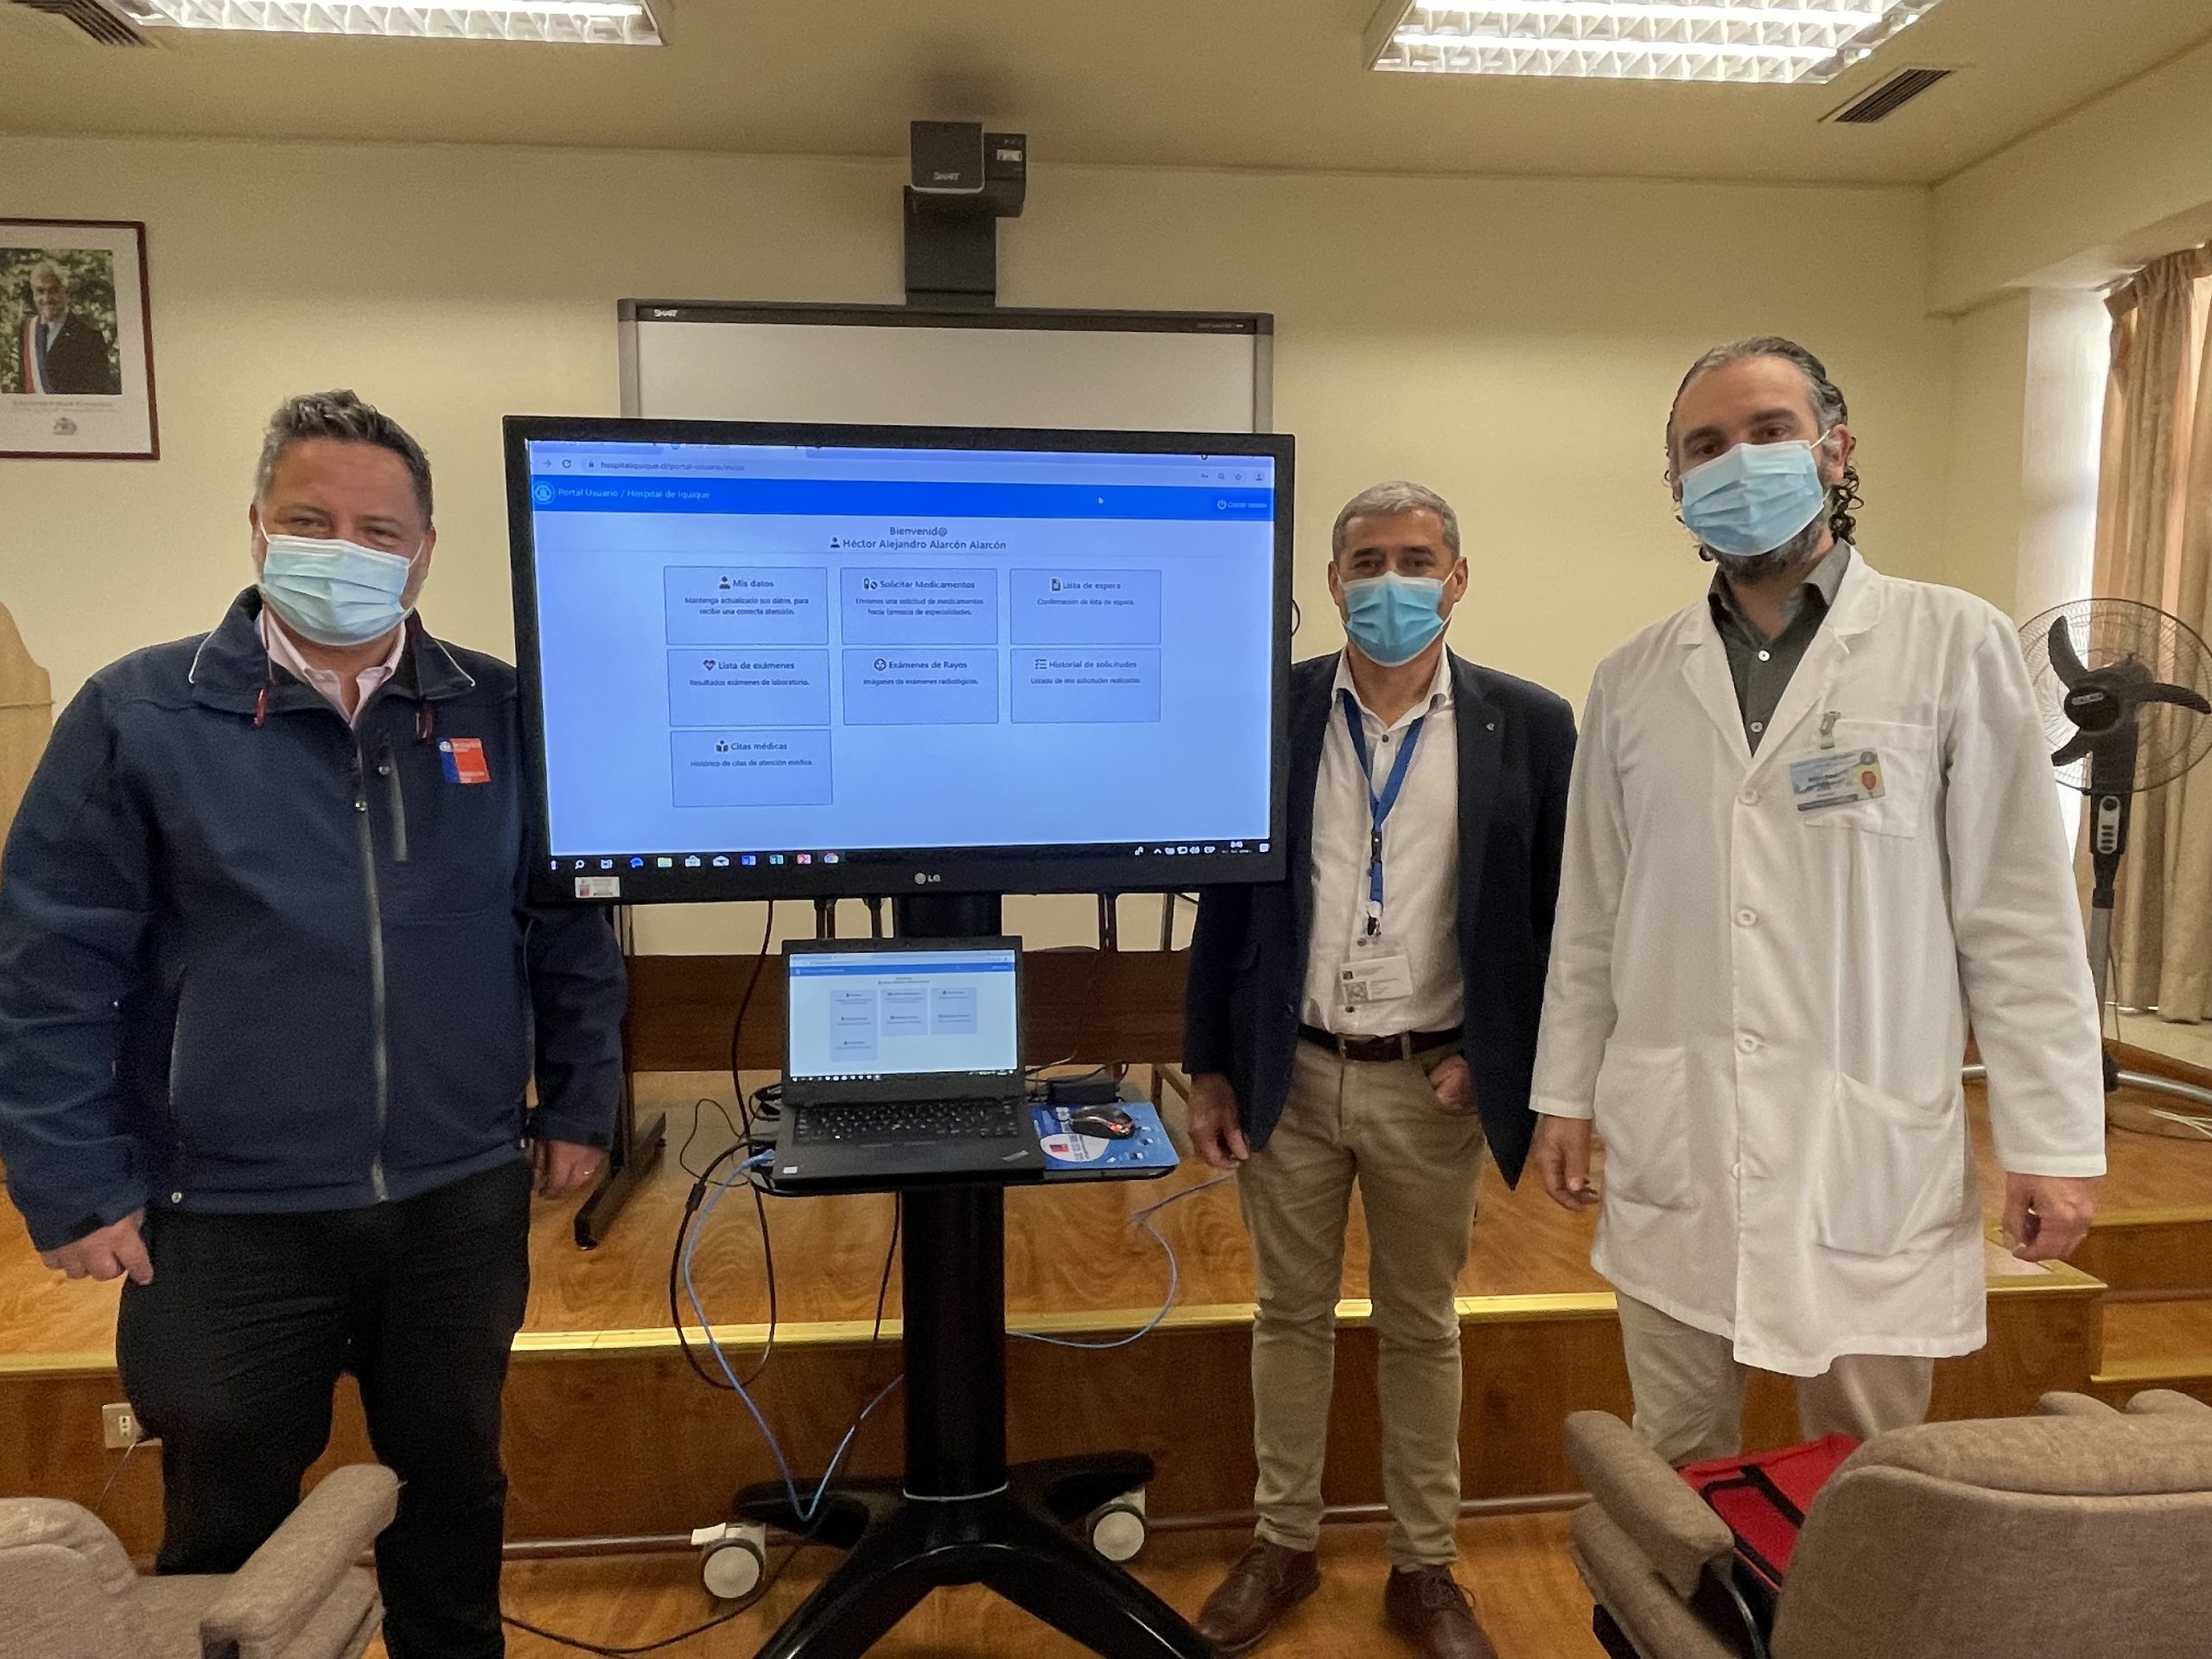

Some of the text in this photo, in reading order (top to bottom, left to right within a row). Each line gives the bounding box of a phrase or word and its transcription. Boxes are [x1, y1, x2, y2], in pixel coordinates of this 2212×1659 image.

[558, 488, 583, 497] Portal
[585, 489, 619, 498] Usuario
[627, 490, 663, 499] Hospital
[678, 491, 710, 500] Iquique
[890, 526, 948, 536] Bienvenid@
[842, 538, 1007, 550] Héctor Alejandro Alarcón Alarcón
[880, 580, 912, 588] Solicitar
[718, 661, 795, 670] Lista de exámenes
[888, 660, 968, 671] Exámenes de Rayos
[730, 741, 788, 751] Citas médicas
